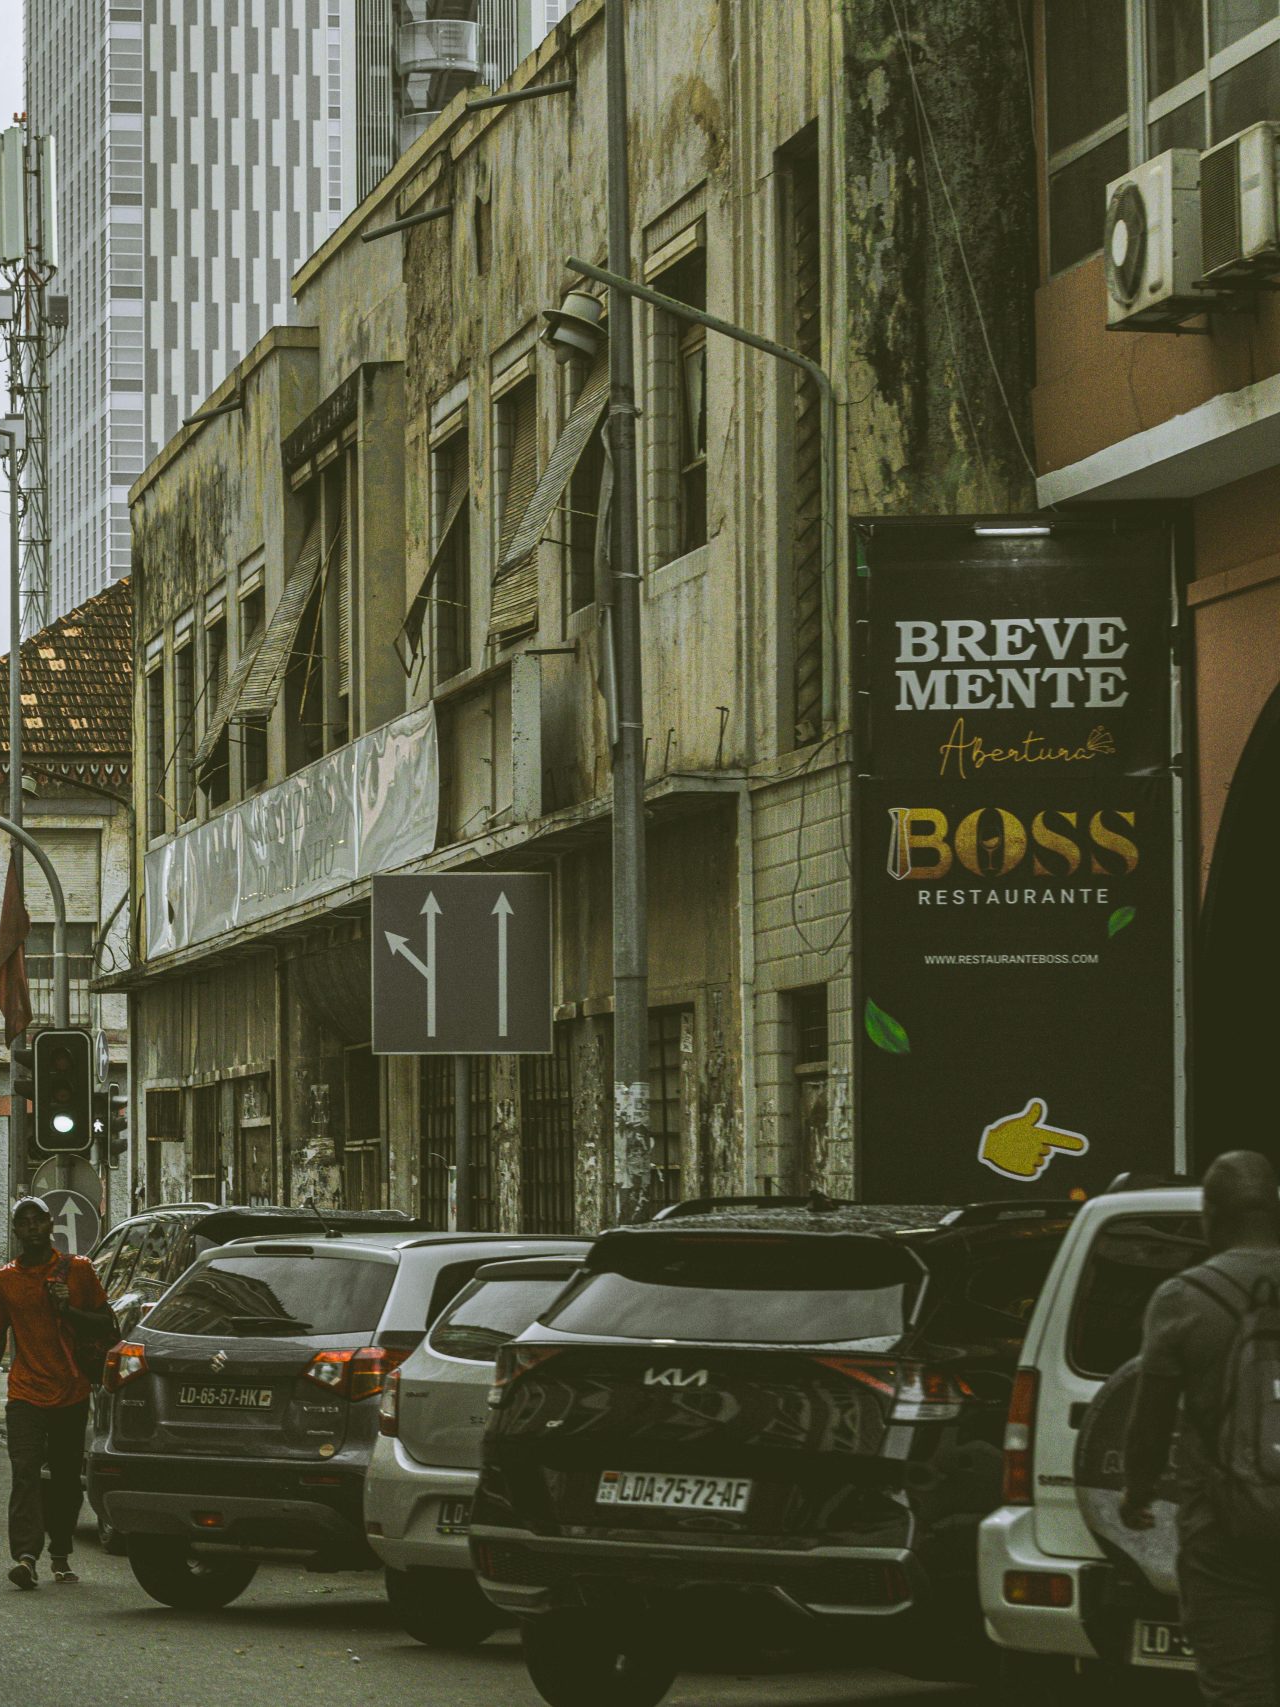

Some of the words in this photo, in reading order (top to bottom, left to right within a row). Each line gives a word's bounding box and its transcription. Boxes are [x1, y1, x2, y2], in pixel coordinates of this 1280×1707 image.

[895, 616, 1130, 663] BREVE
[895, 666, 1130, 711] MENTE
[939, 717, 1096, 779] Abertura
[887, 807, 1140, 880] BOSS
[918, 888, 1109, 905] RESTAURANTE
[924, 954, 1099, 965] WWW.RESTAURANTEBOSS.COM
[644, 1368, 708, 1386] KIA
[180, 1386, 259, 1406] LD-65-57-HK
